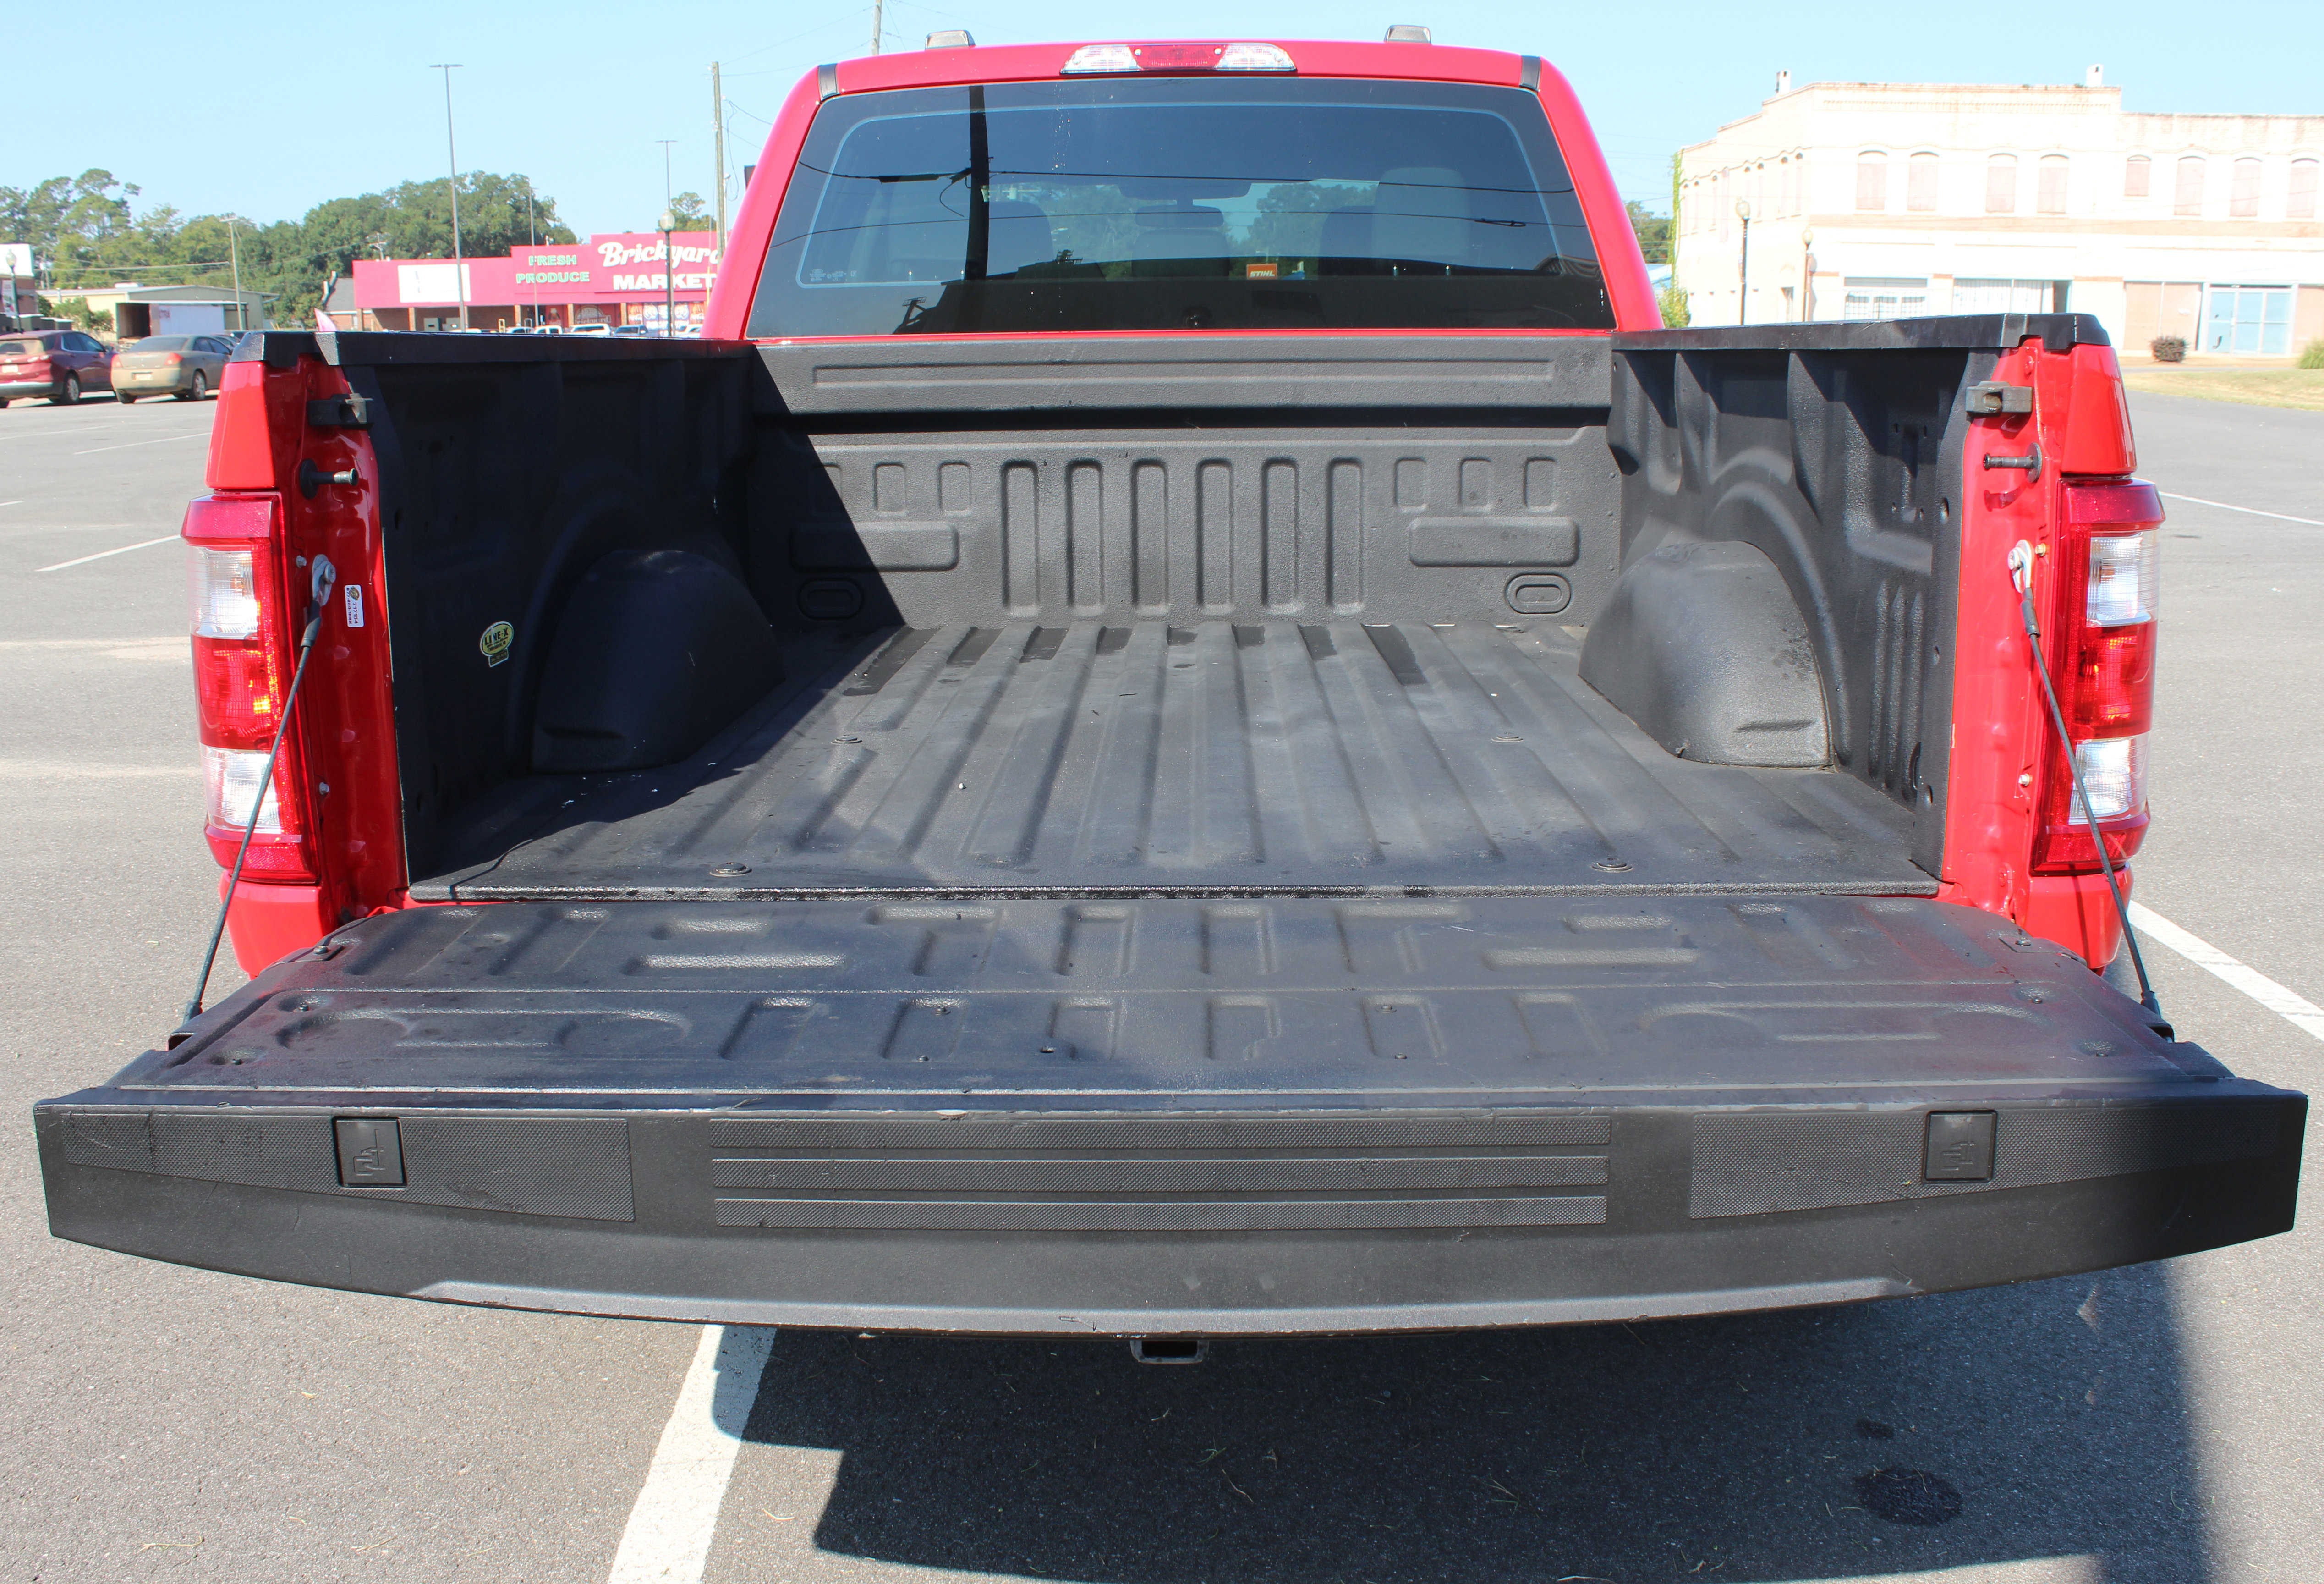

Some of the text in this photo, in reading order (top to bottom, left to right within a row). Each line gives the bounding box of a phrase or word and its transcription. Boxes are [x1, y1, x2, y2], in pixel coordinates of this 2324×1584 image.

[528, 255, 577, 266] FRESH
[516, 272, 590, 283] PRODUCE
[613, 273, 717, 290] MARKET
[484, 627, 508, 645] LINE-X
